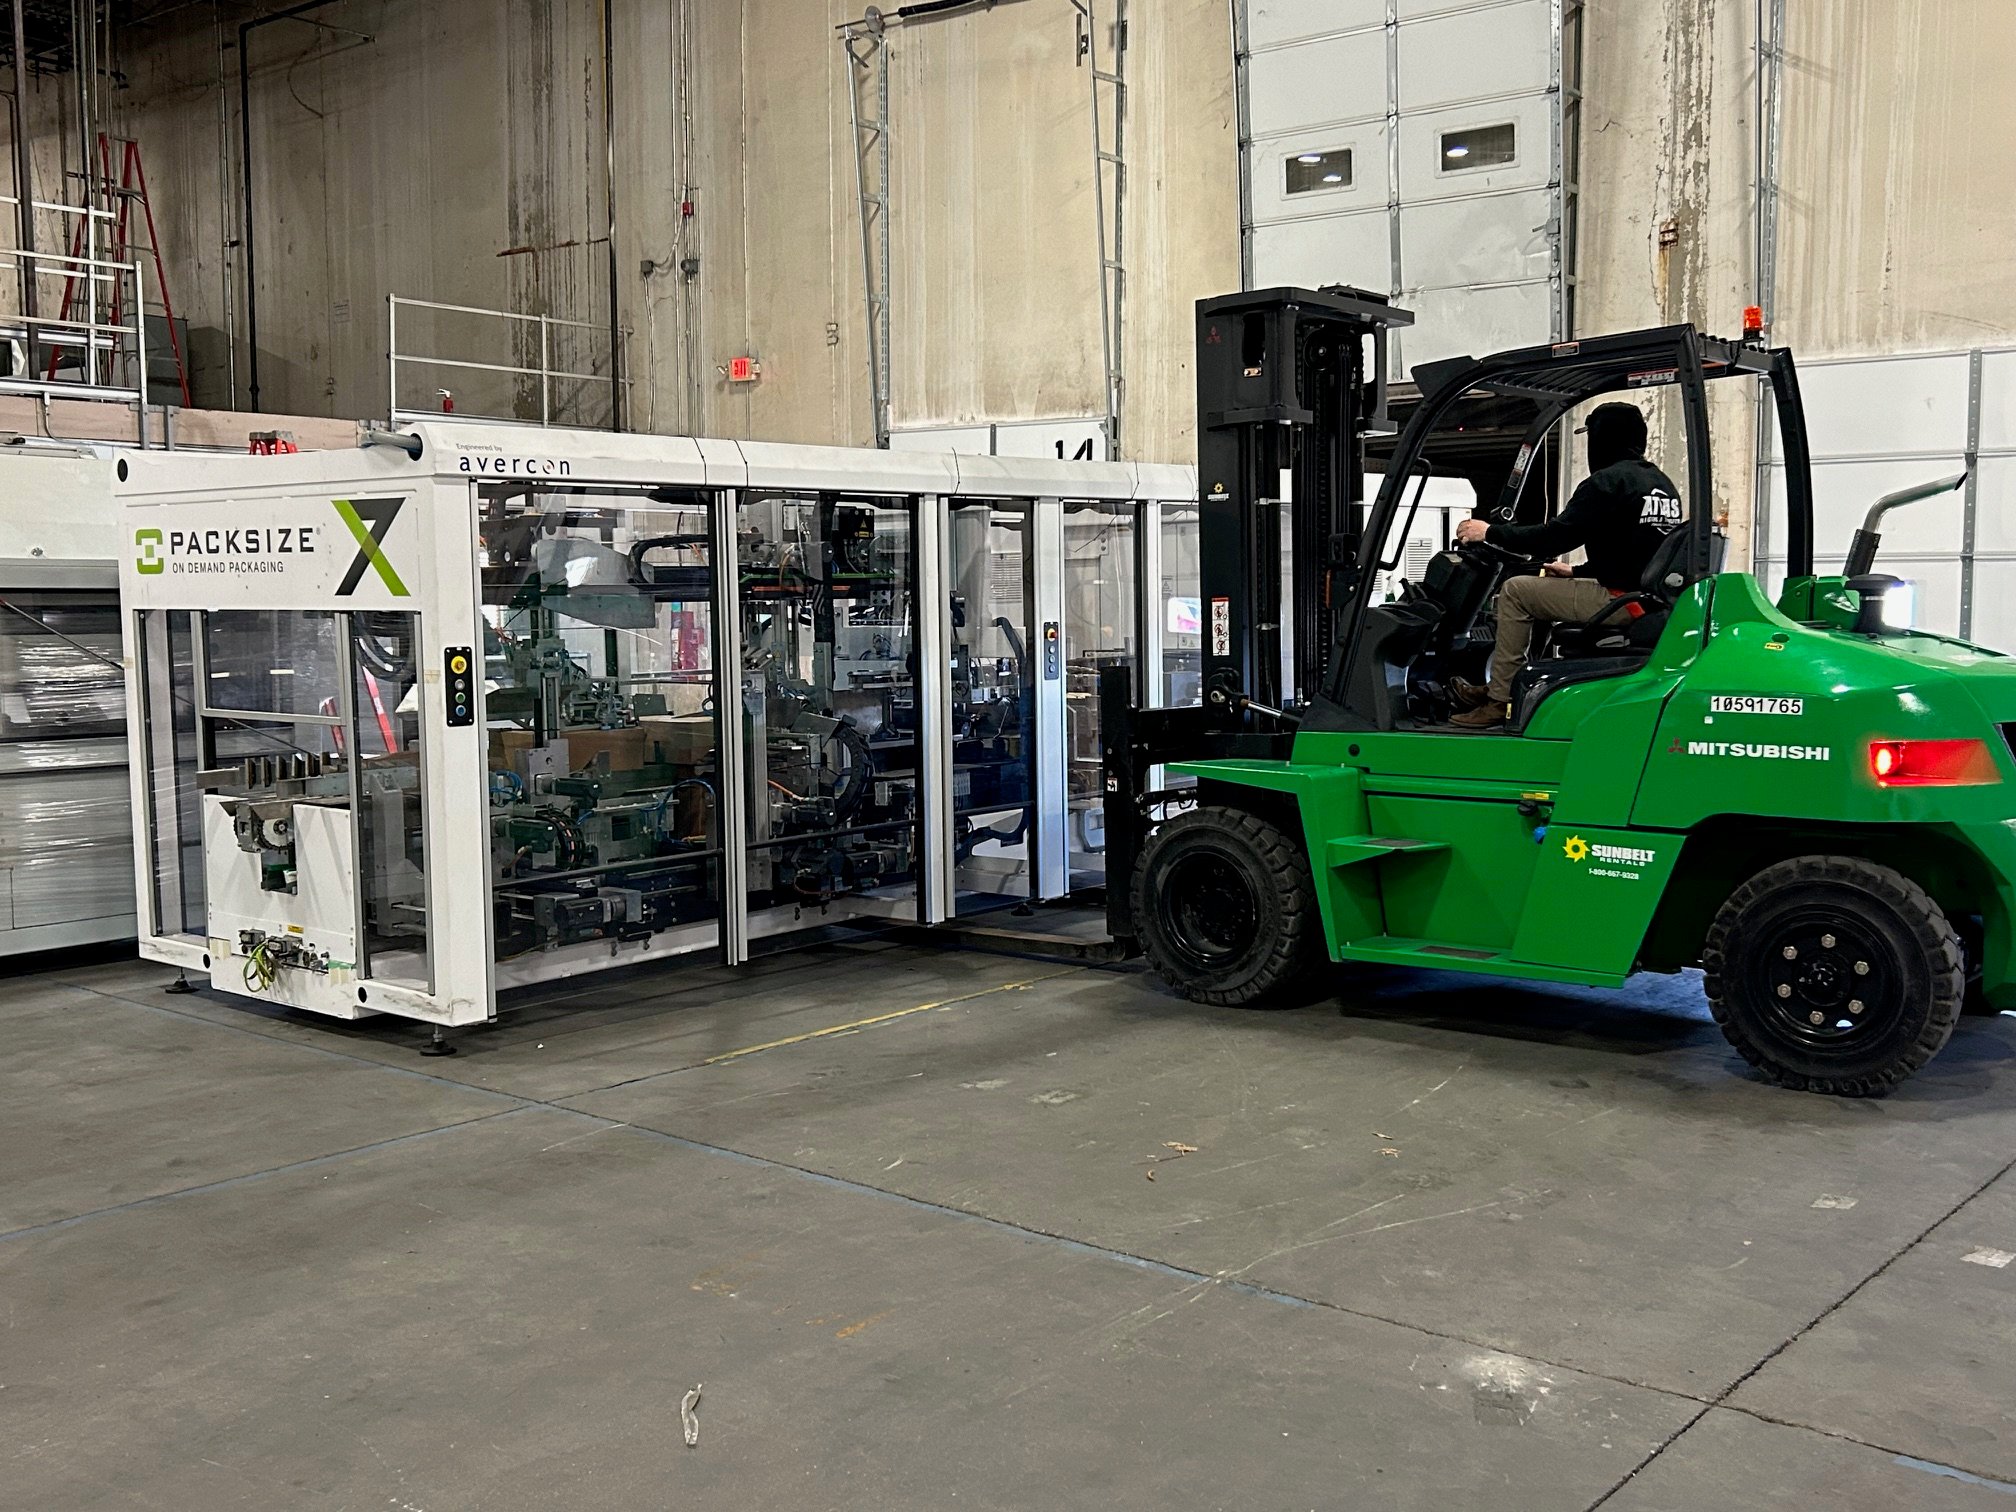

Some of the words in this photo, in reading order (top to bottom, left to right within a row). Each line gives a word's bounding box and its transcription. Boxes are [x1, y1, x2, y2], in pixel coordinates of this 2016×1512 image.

[1055, 438, 1093, 461] 14
[459, 456, 570, 475] avercon
[170, 527, 315, 555] PACKSIZE
[172, 562, 185, 574] ON
[188, 561, 225, 574] DEMAND
[229, 561, 284, 573] PACKAGING
[1712, 697, 1801, 714] 10591765
[1688, 741, 1830, 761] MITSUBISHI
[1591, 844, 1656, 863] SUNBELT
[1599, 856, 1646, 867] RENTALS
